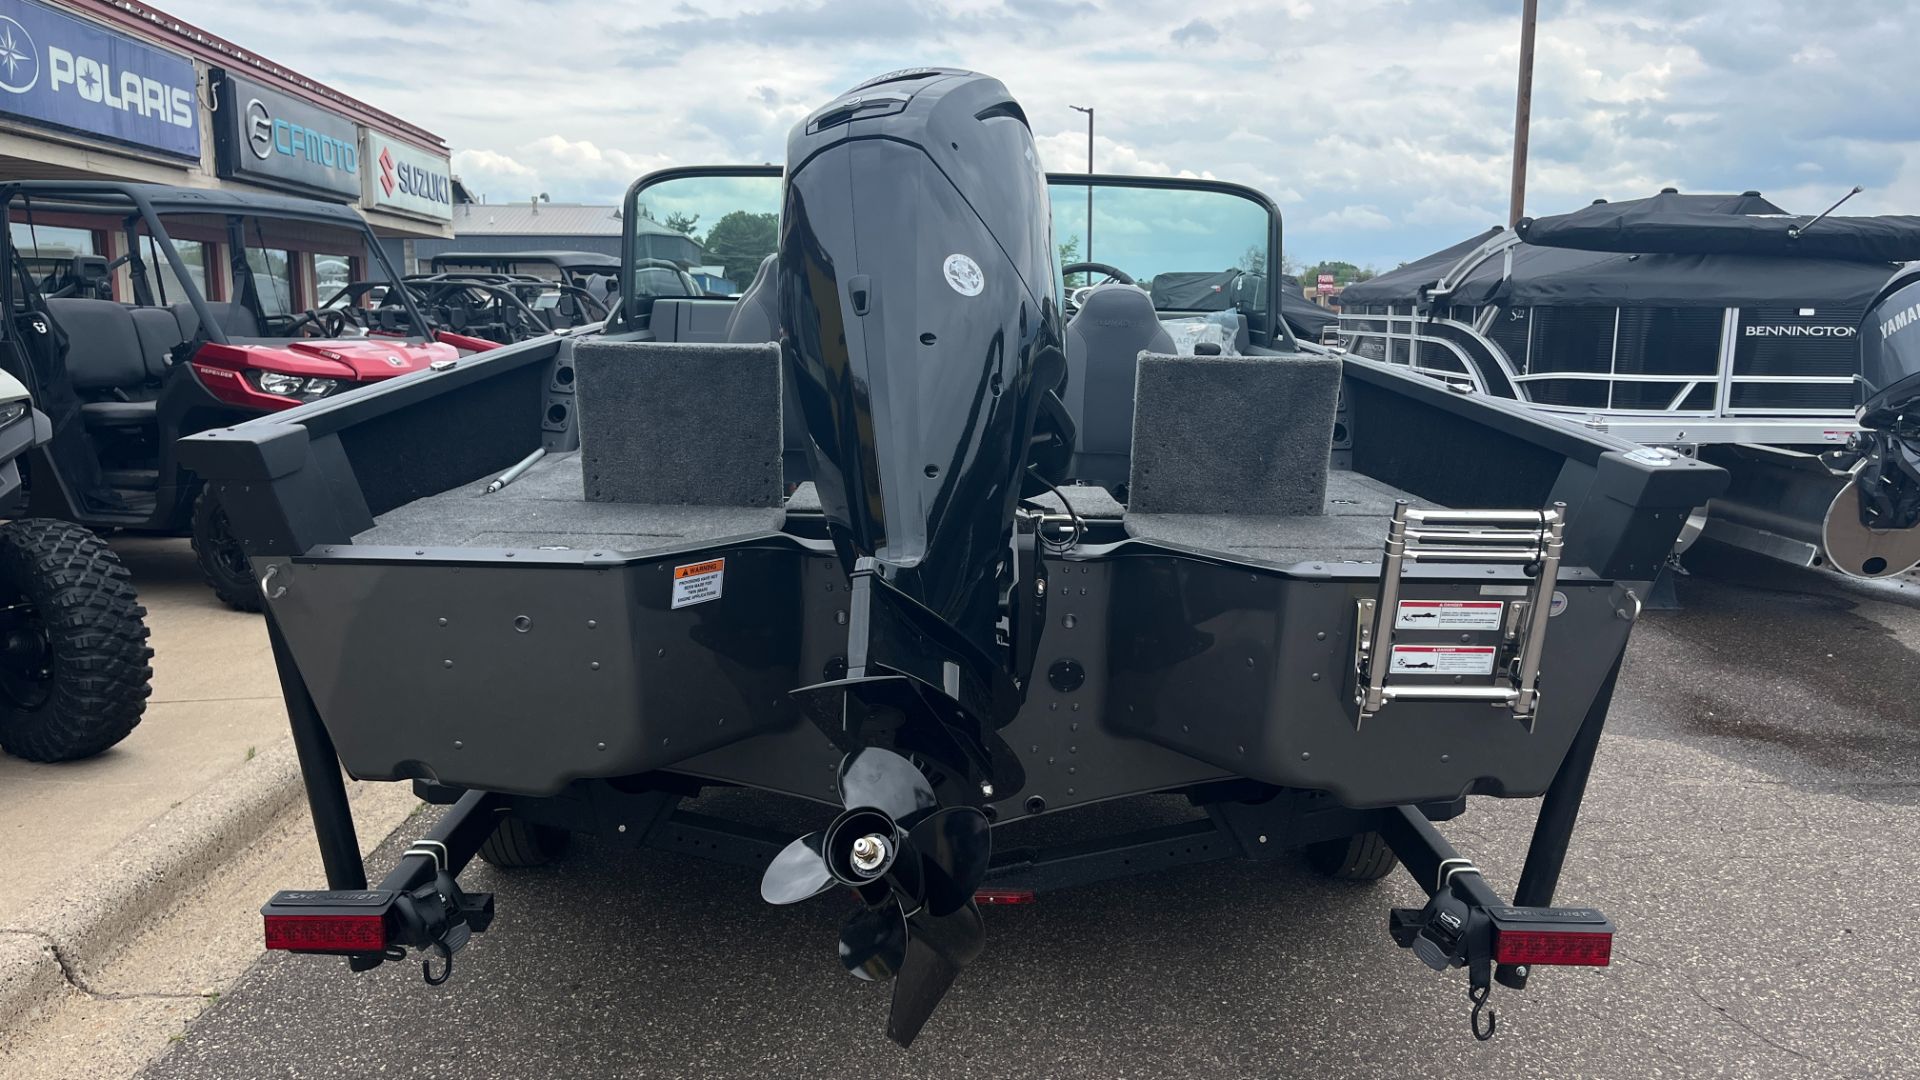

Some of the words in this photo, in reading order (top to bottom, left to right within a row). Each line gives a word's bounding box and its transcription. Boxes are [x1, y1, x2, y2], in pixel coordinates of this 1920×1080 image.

[49, 46, 193, 129] POLARIS
[272, 117, 357, 174] CFMOTO
[397, 162, 450, 205] SUZUKI
[201, 367, 233, 379] DEFENDER
[690, 563, 717, 574] WARNING
